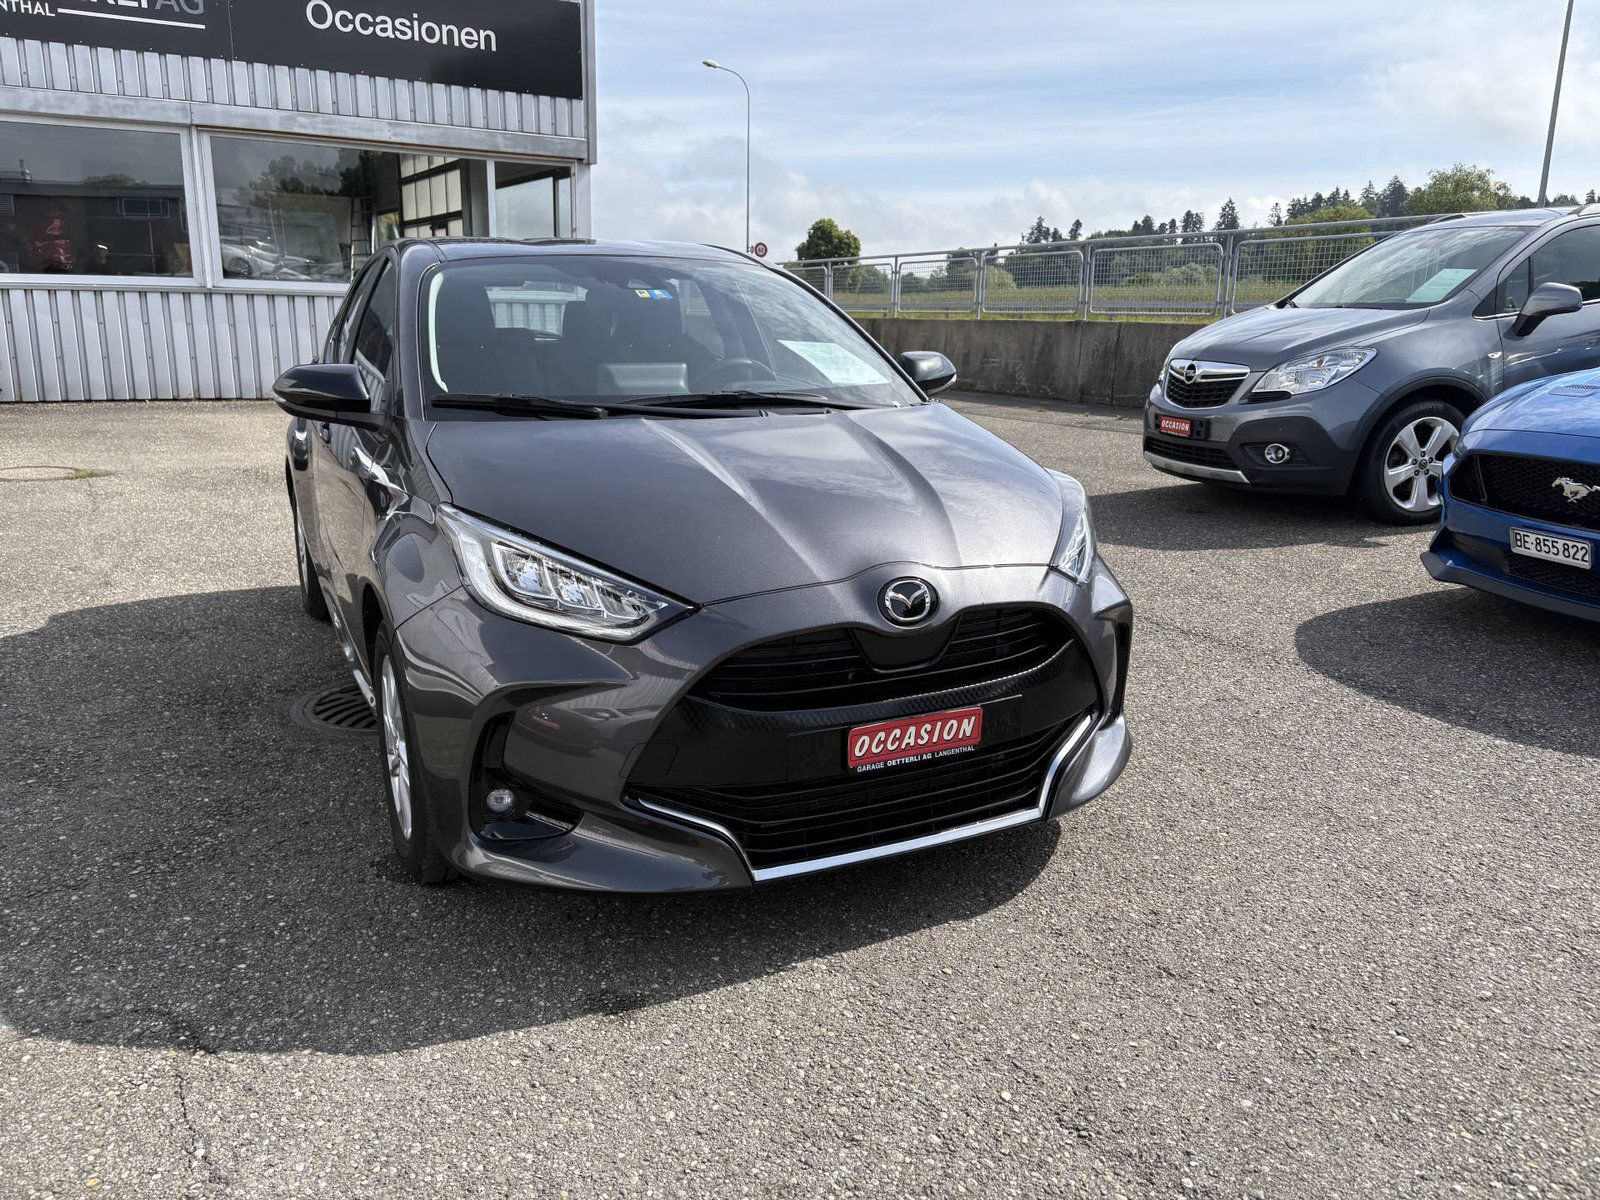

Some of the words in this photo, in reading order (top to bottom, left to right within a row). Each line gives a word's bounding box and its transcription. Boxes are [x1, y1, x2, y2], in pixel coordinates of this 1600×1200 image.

[306, 0, 497, 52] Occasionen
[1162, 420, 1189, 431] OCCASION
[854, 716, 976, 757] OCCASION
[857, 763, 885, 773] GARAGE
[887, 756, 920, 767] OETTERLI
[935, 746, 975, 757] LANGENTHAL
